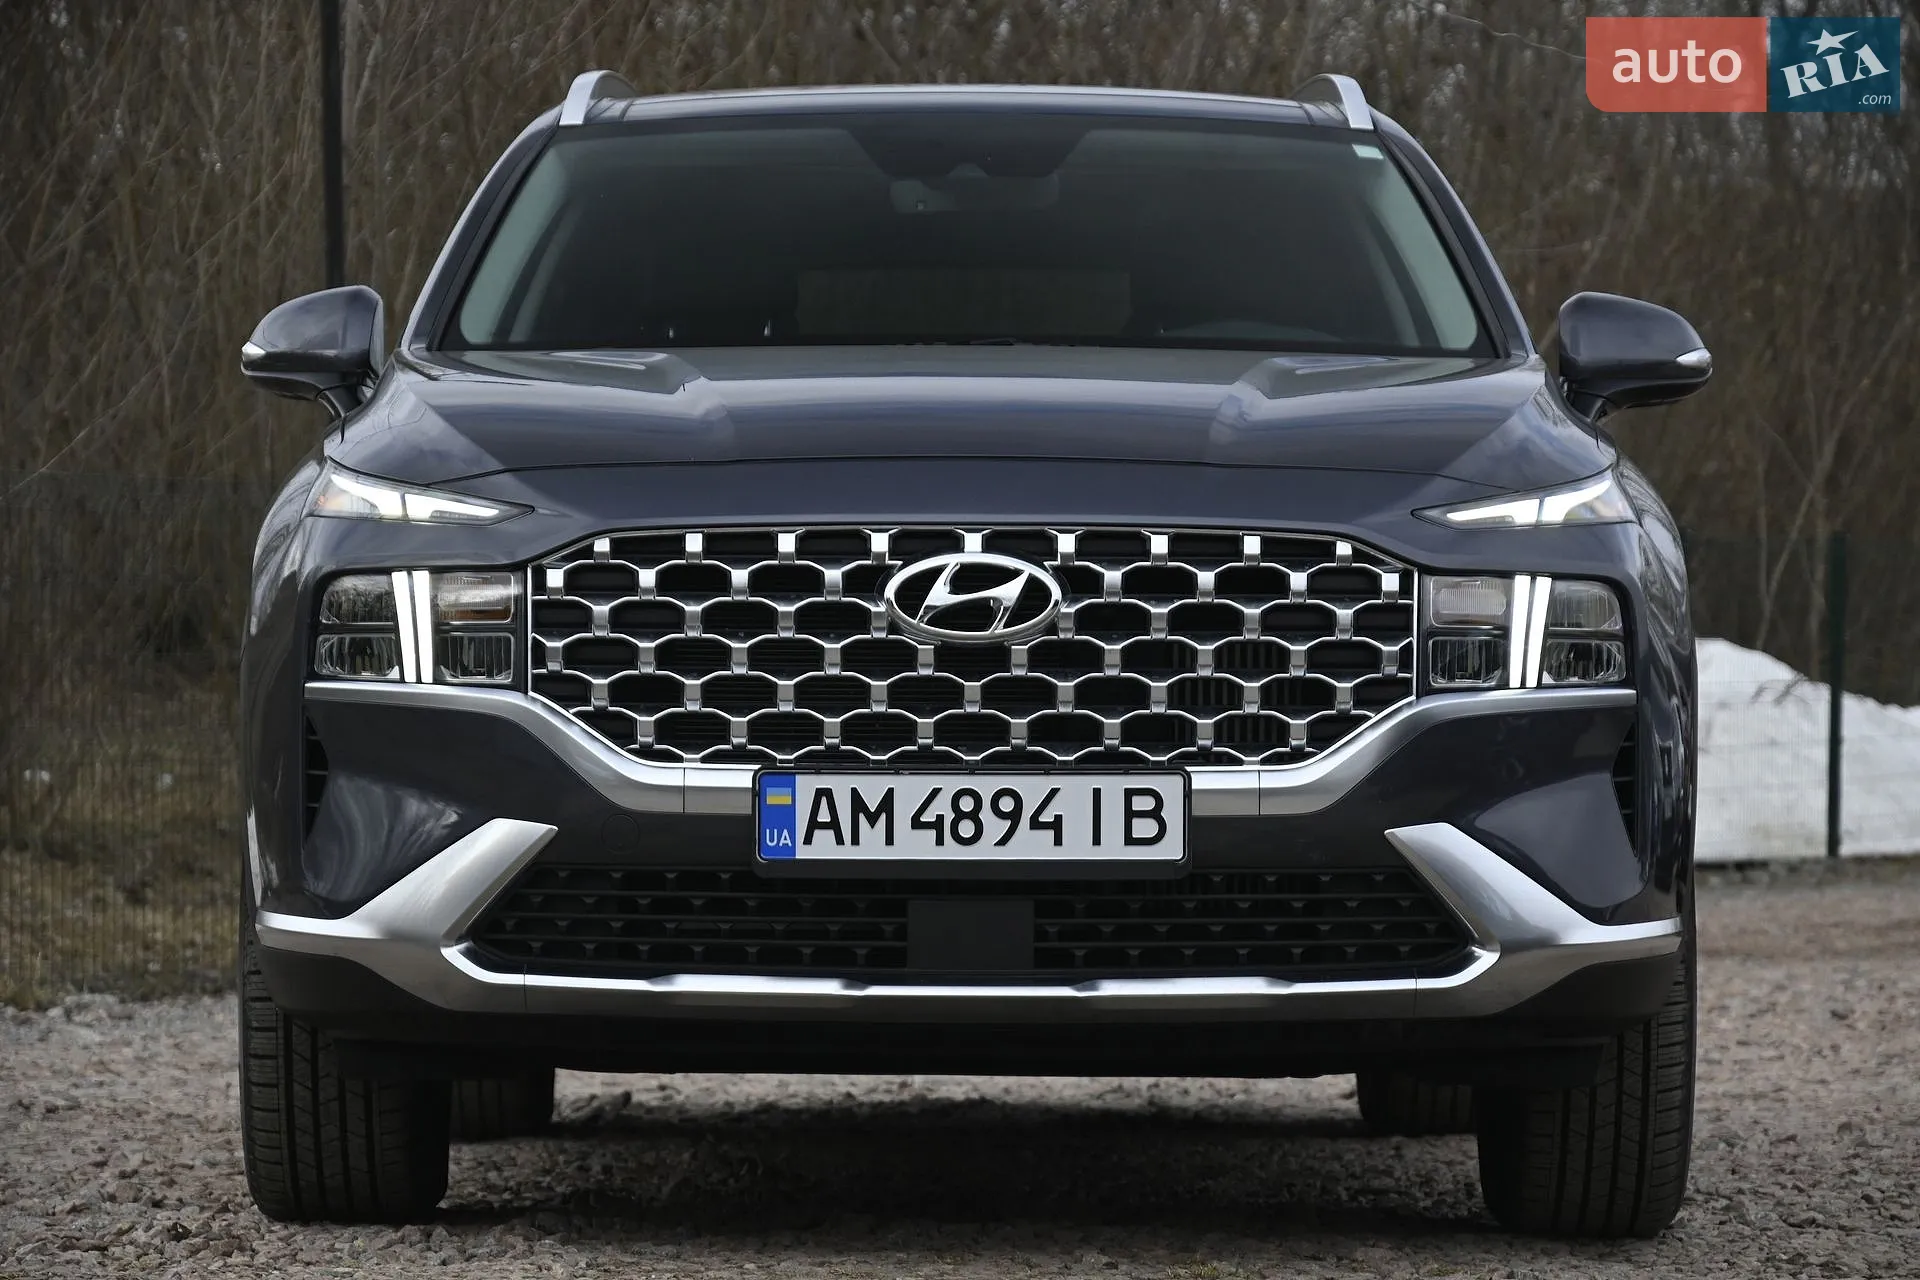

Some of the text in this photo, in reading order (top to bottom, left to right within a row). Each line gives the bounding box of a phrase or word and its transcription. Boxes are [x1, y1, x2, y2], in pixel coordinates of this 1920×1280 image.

[802, 787, 1168, 846] AM 4894 IB
[766, 829, 792, 847] UA
